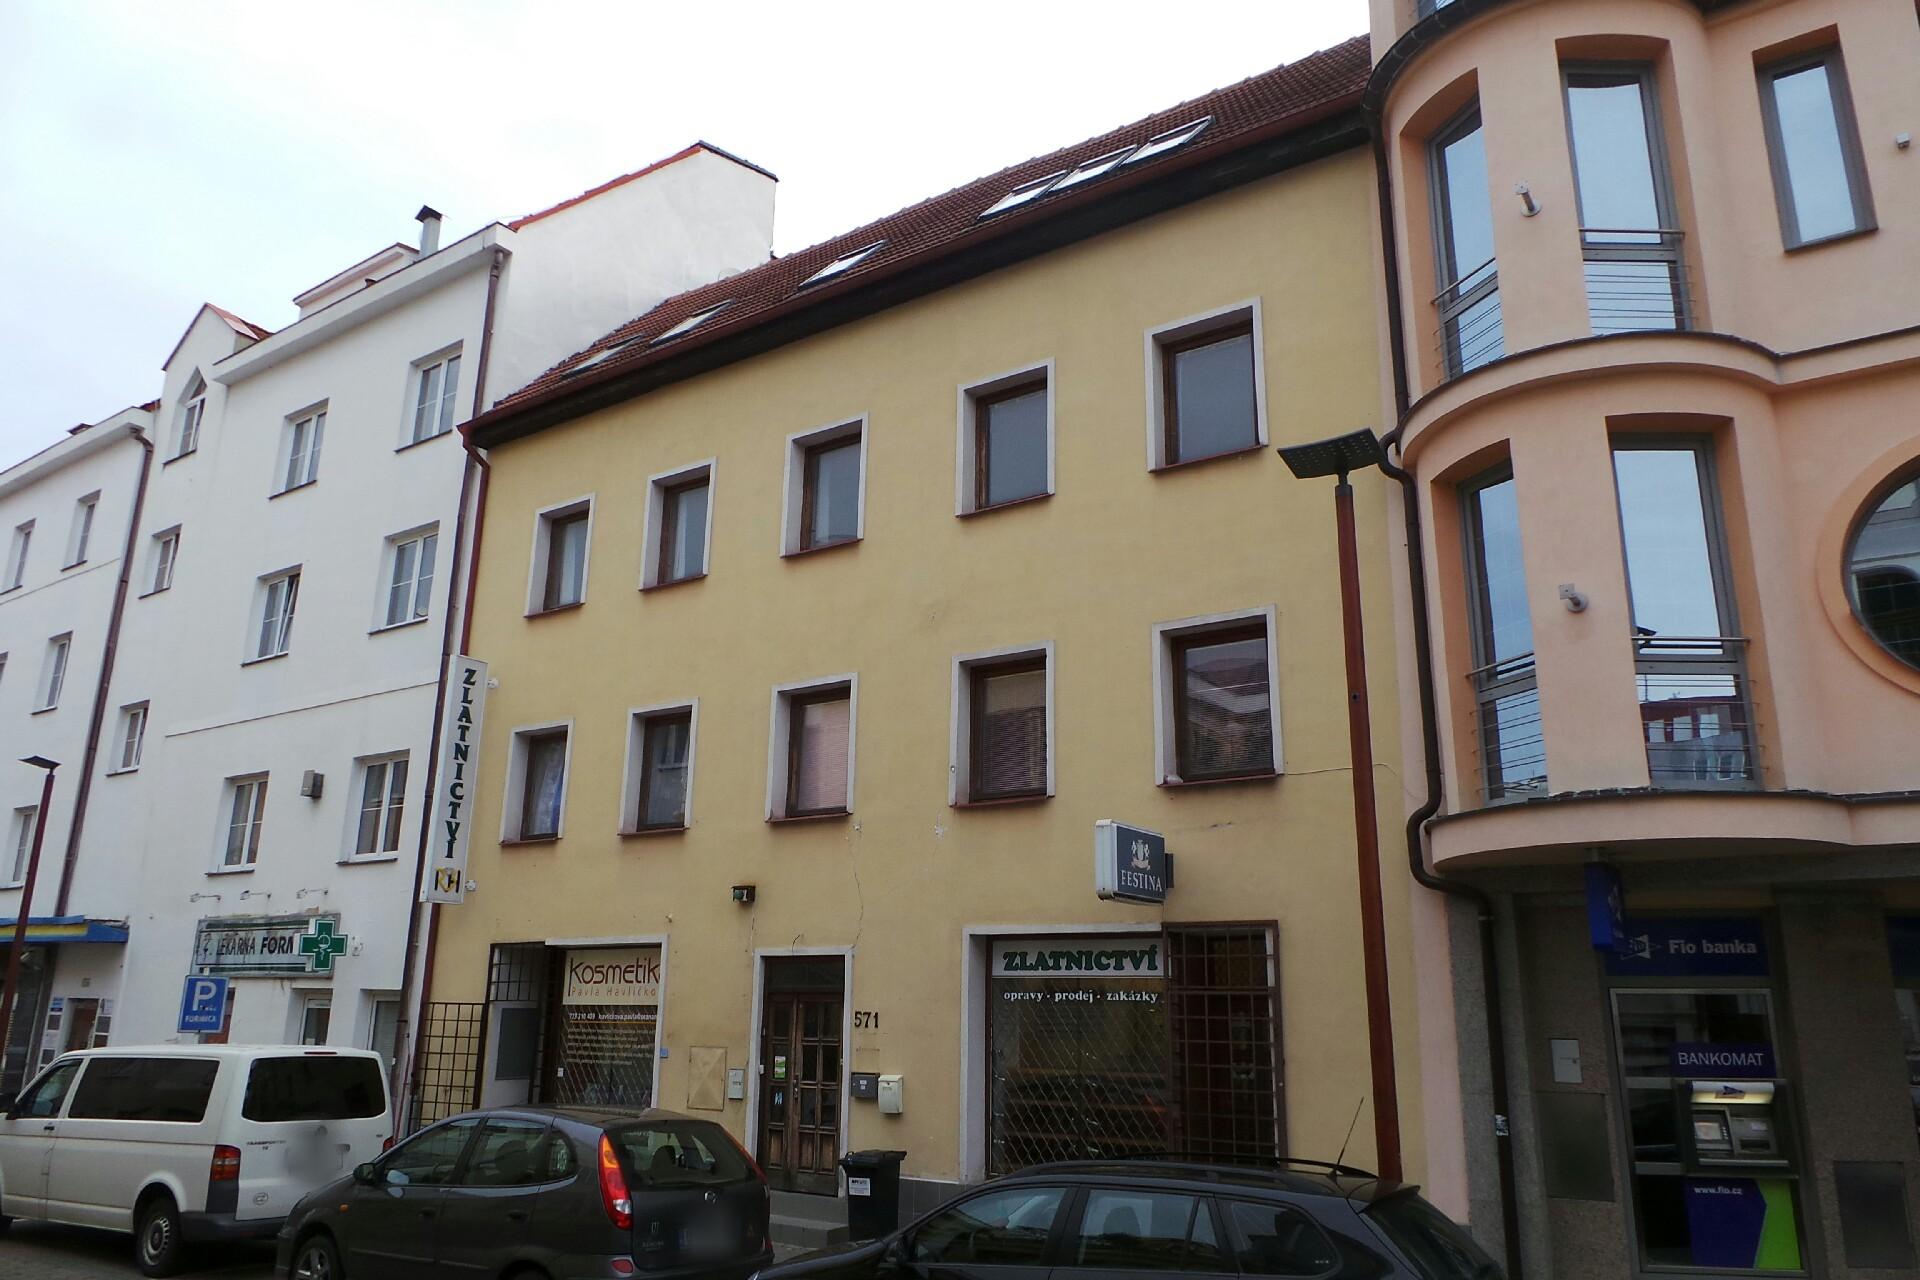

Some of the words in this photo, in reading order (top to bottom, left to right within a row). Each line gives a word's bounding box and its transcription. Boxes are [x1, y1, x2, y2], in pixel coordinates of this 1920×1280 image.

[1121, 870, 1163, 892] FESTINA
[1668, 939, 1697, 955] Fio
[1702, 939, 1757, 955] banka
[1003, 945, 1158, 972] ZLATNICTVÍ
[567, 957, 661, 997] Kosmetik
[192, 981, 217, 1011] P
[1003, 991, 1044, 1002] opravy
[1055, 990, 1094, 1004] prodej
[1106, 991, 1159, 1004] zakázky
[854, 1011, 879, 1029] 571
[1678, 1052, 1764, 1067] BANKOMAT
